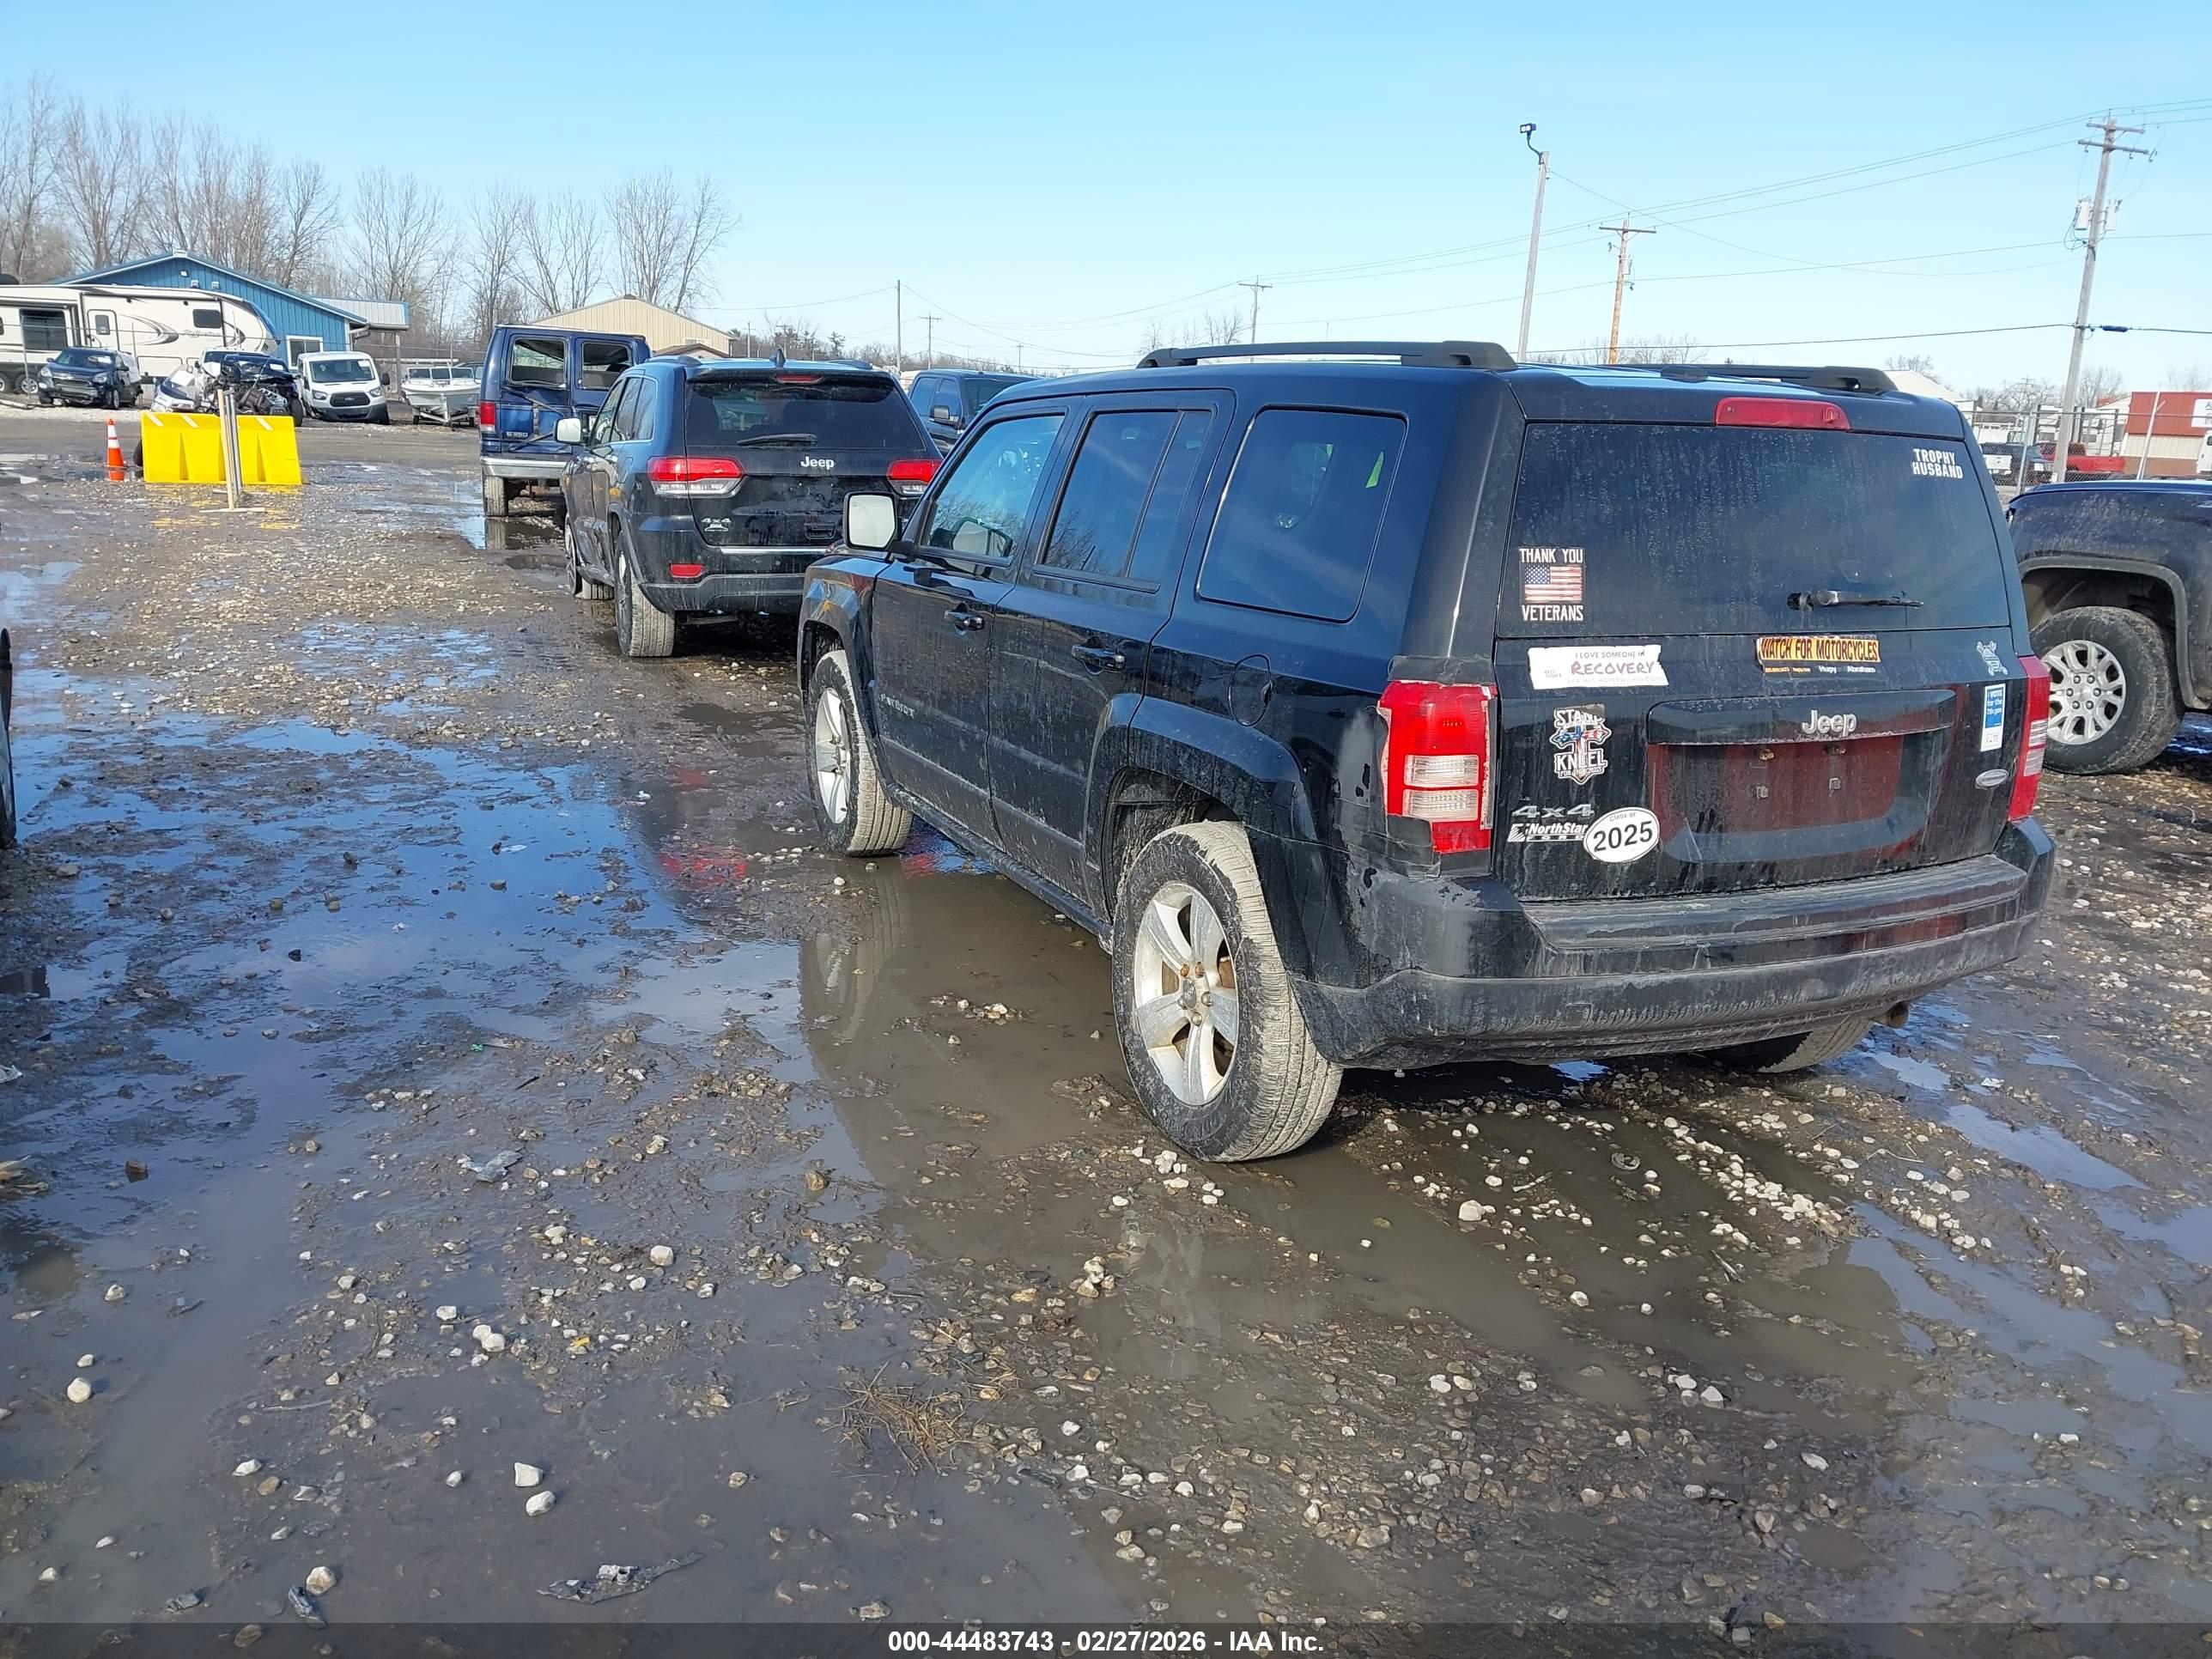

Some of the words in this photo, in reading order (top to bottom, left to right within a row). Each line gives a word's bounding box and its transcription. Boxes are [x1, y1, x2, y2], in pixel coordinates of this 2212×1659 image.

[800, 456, 835, 470] Jeep
[1913, 447, 1955, 465] TROPHY
[1912, 461, 1964, 479] HUSBAND
[1519, 548, 1557, 563] THANK
[1561, 548, 1583, 563] YOU
[1522, 605, 1584, 621] VETERANS
[1760, 638, 1792, 659] WATCH
[1796, 638, 1812, 659] FOR
[1816, 640, 1878, 661] MOTORCYCLES
[1571, 660, 1655, 676] RECOVERY
[1802, 709, 1856, 737] Jeep
[1512, 804, 1595, 818] 4x4
[1528, 822, 1589, 834] NorthStar
[1593, 821, 1653, 853] 2025
